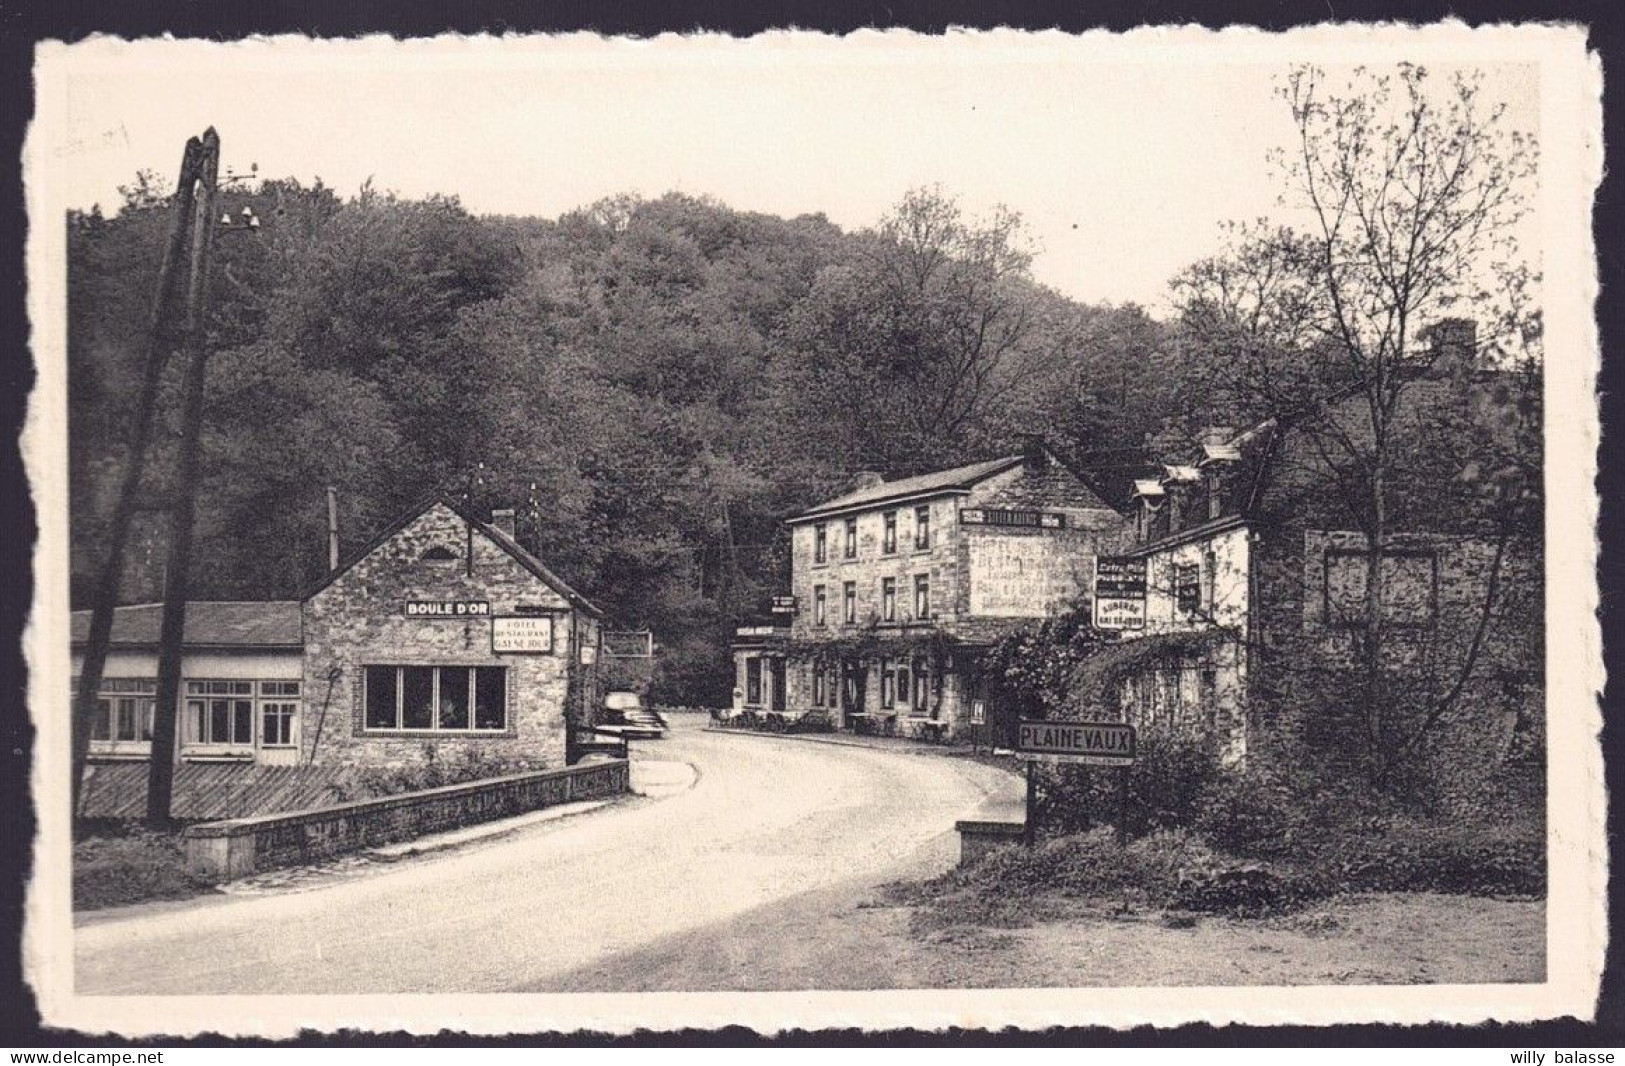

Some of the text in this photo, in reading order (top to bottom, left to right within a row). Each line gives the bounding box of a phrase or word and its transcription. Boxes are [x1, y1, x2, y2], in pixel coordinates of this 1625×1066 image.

[408, 603, 488, 615] BOULE D'OR
[1020, 727, 1129, 751] PLAINEVAUX
